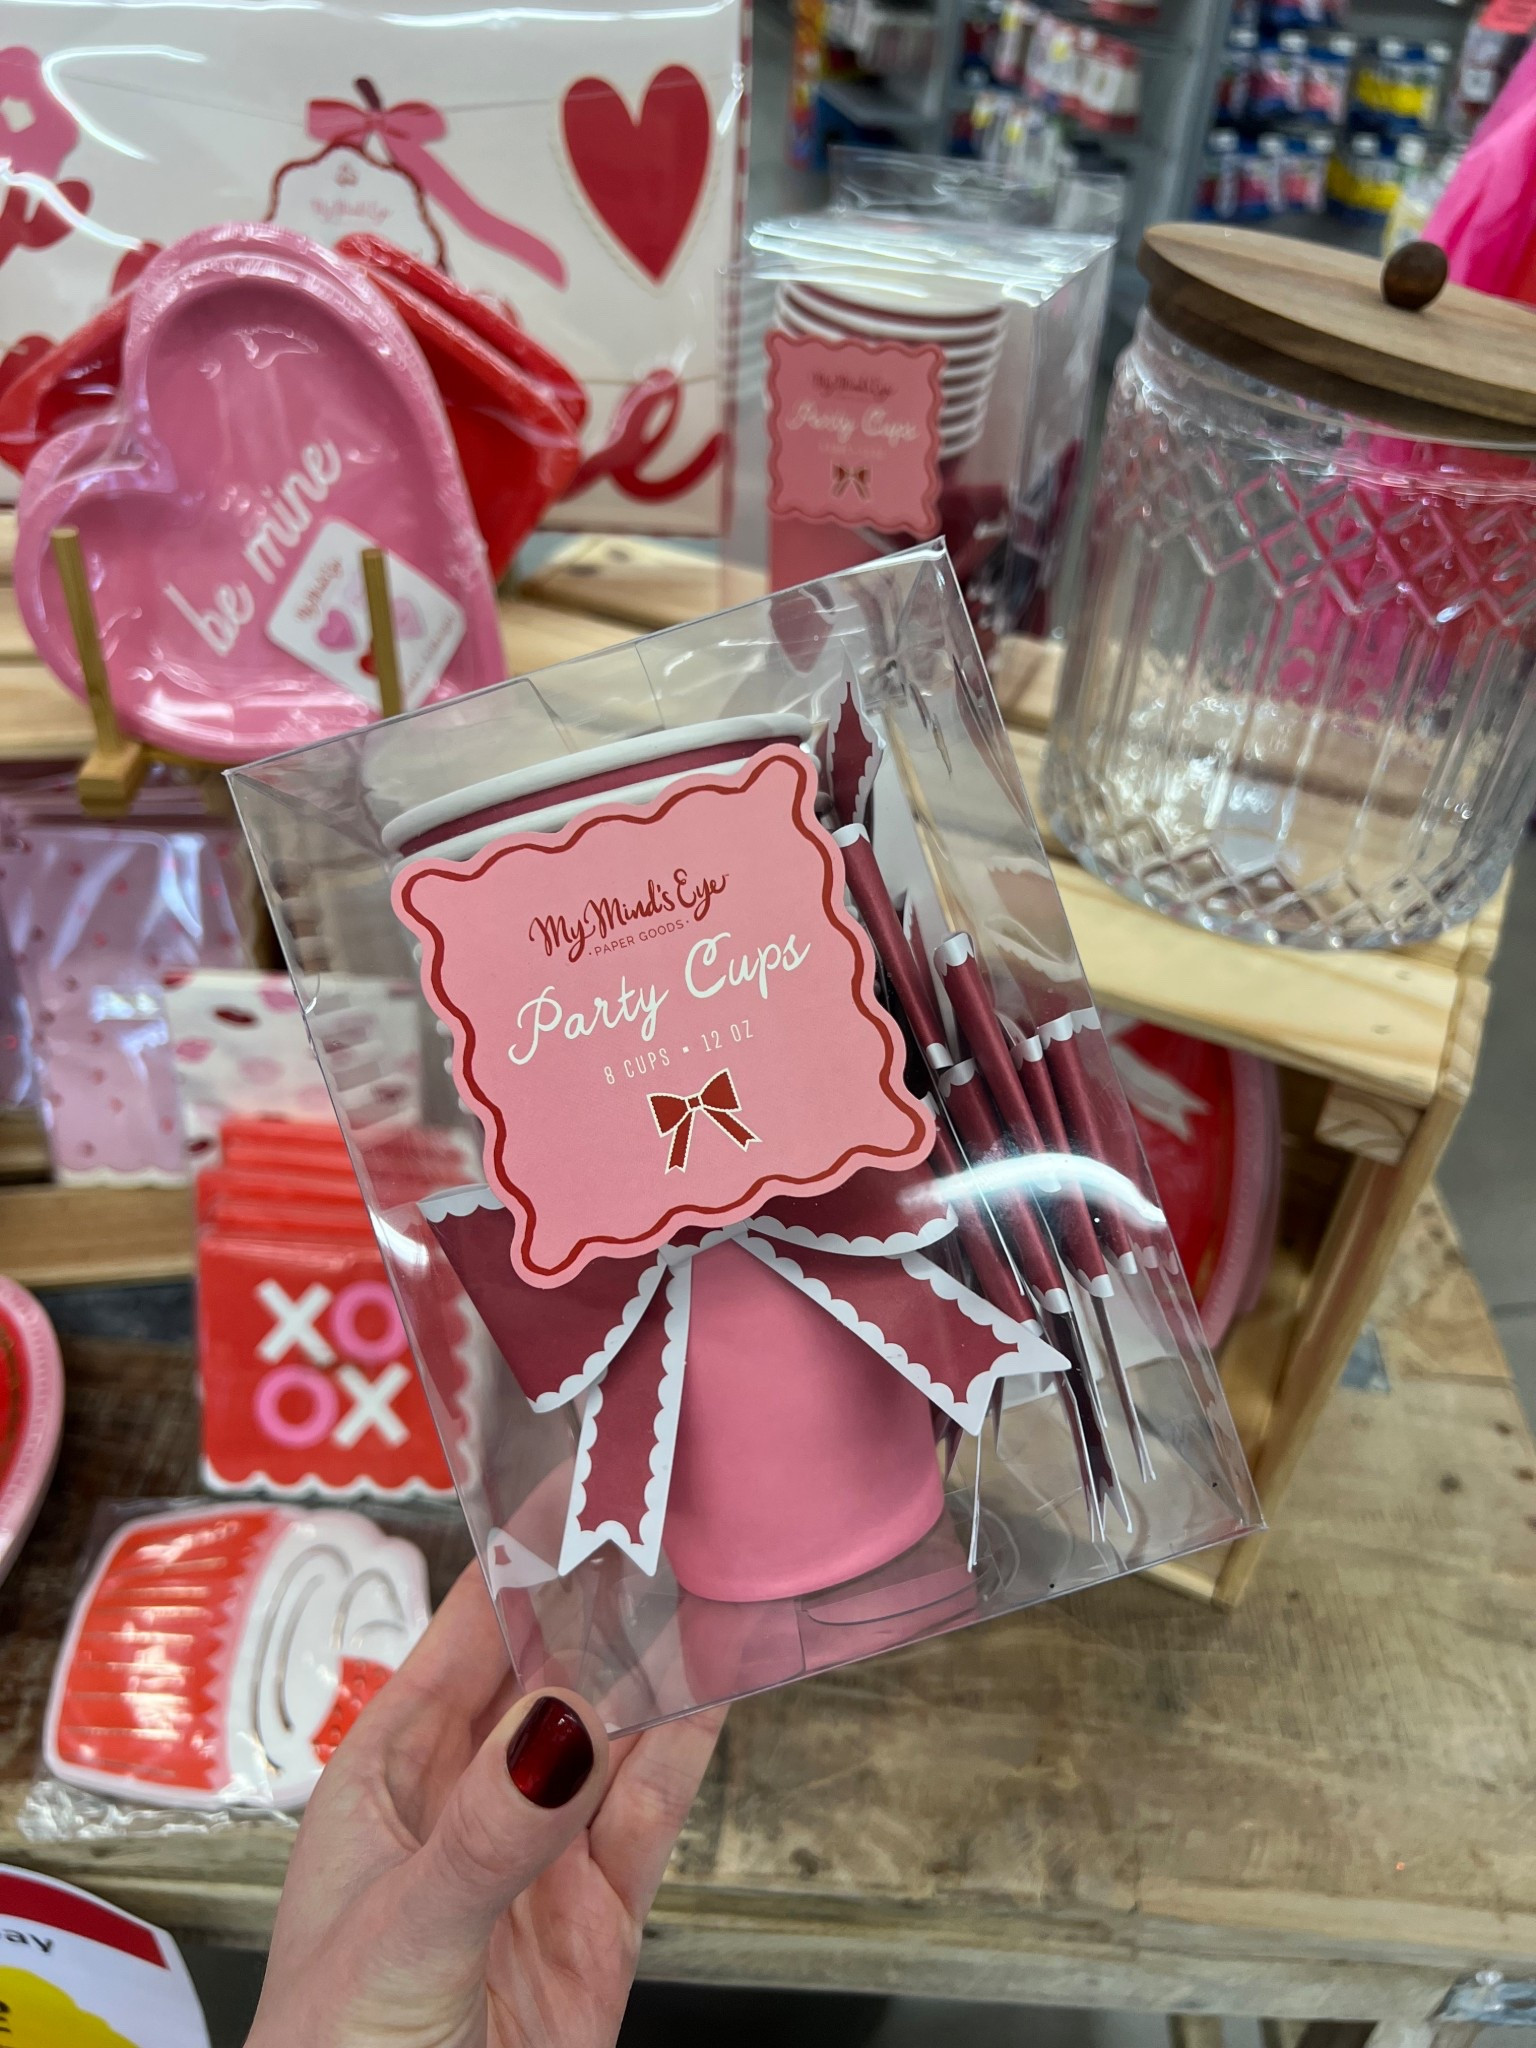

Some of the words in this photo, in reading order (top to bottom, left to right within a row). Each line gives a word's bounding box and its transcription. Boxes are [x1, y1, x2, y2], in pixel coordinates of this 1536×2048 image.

[163, 582, 254, 656] be
[244, 440, 341, 584] mine
[528, 915, 596, 963] My
[583, 879, 676, 939] Mind's
[673, 868, 727, 922] Eye
[594, 936, 636, 957] PAPER
[638, 919, 684, 942] GOODS
[508, 976, 670, 1066] Party
[685, 932, 812, 1000] Cups
[603, 1066, 616, 1085] 8
[623, 1048, 671, 1079] CUPS
[700, 1030, 723, 1053] 12
[730, 1020, 754, 1043] OZ
[0, 1928, 54, 1954] ay
